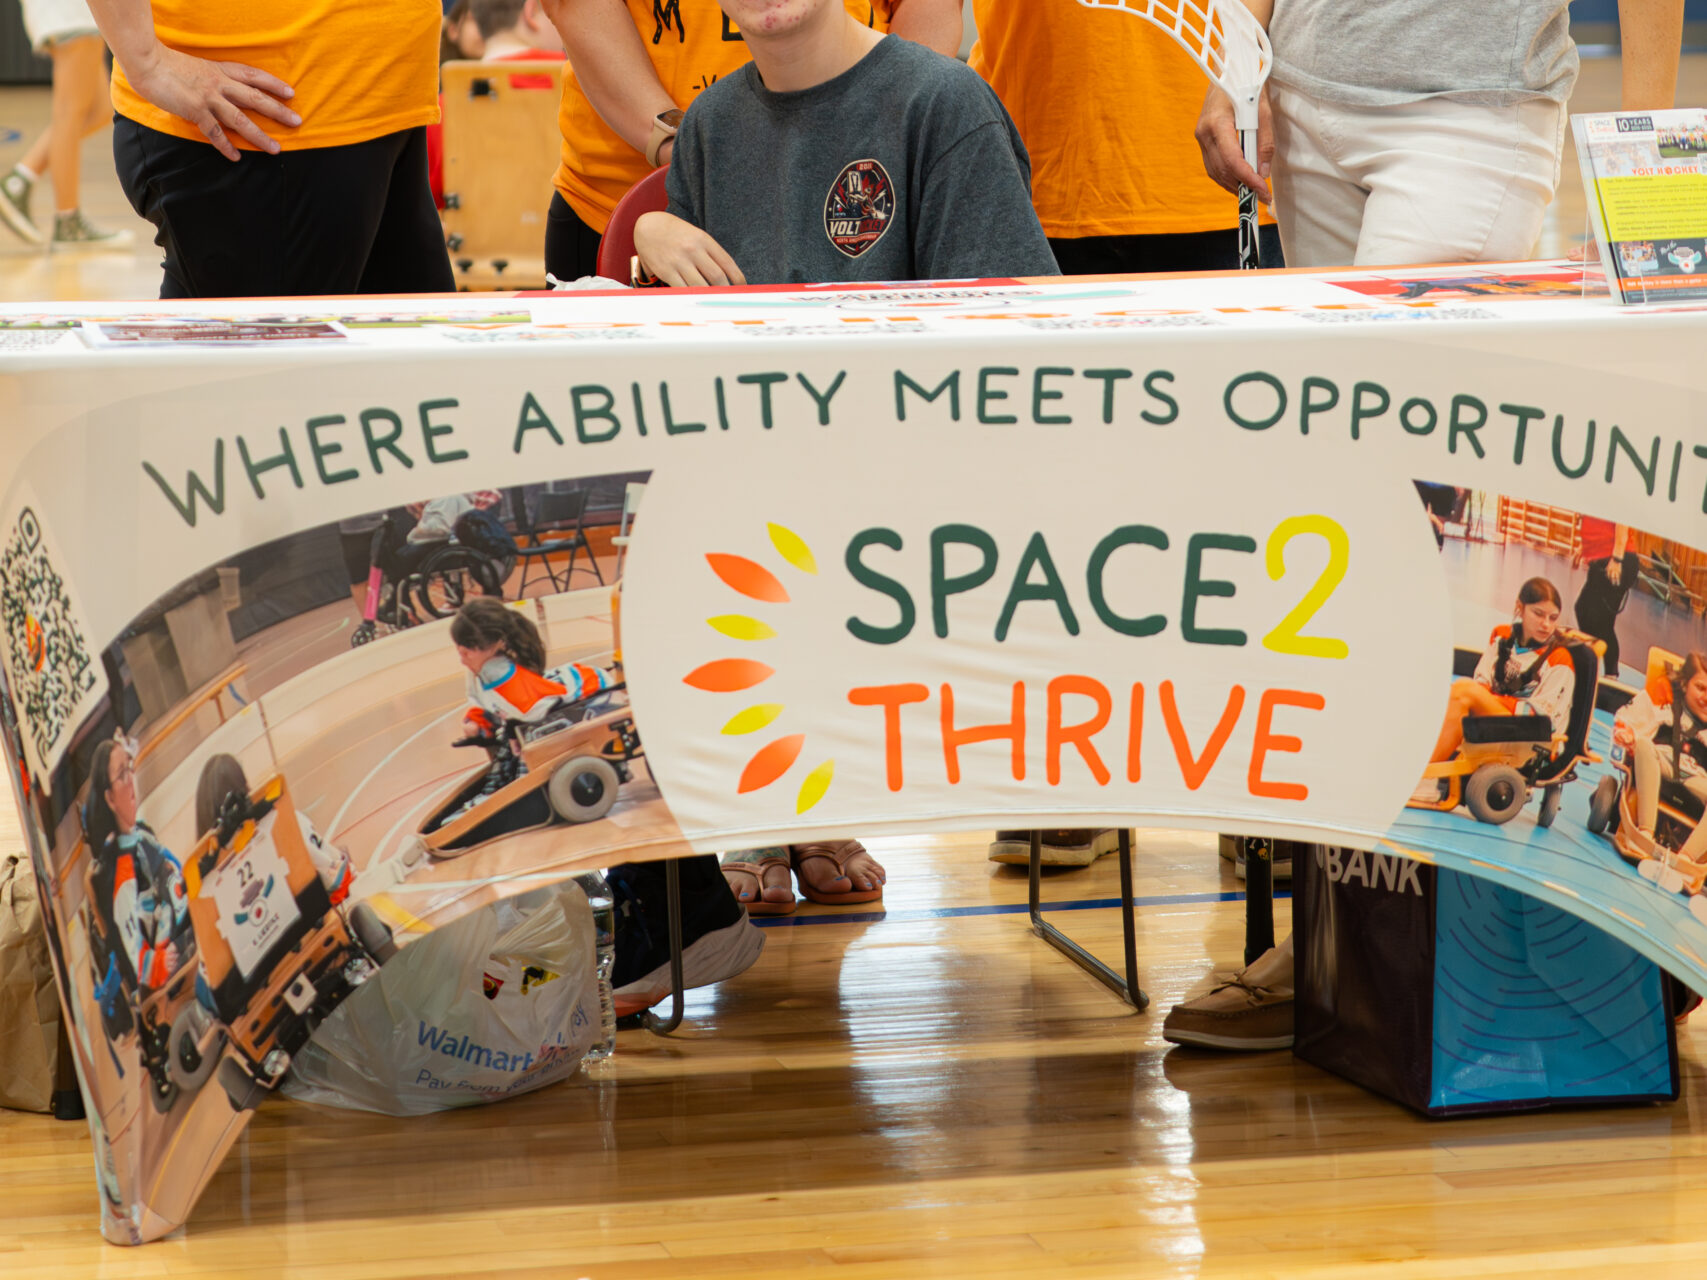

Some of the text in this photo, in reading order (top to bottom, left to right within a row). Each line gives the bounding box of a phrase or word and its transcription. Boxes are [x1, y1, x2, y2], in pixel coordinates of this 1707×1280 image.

[1618, 118, 1631, 132] 10
[829, 220, 862, 237] VOLT
[141, 396, 470, 528] WHERE
[512, 369, 848, 455] ABILITY
[894, 366, 1181, 425] MEETS
[844, 514, 1351, 660] SPACE2
[846, 674, 1327, 802] THRIVE
[1324, 841, 1425, 897] BANK
[417, 1019, 535, 1073] Walmart
